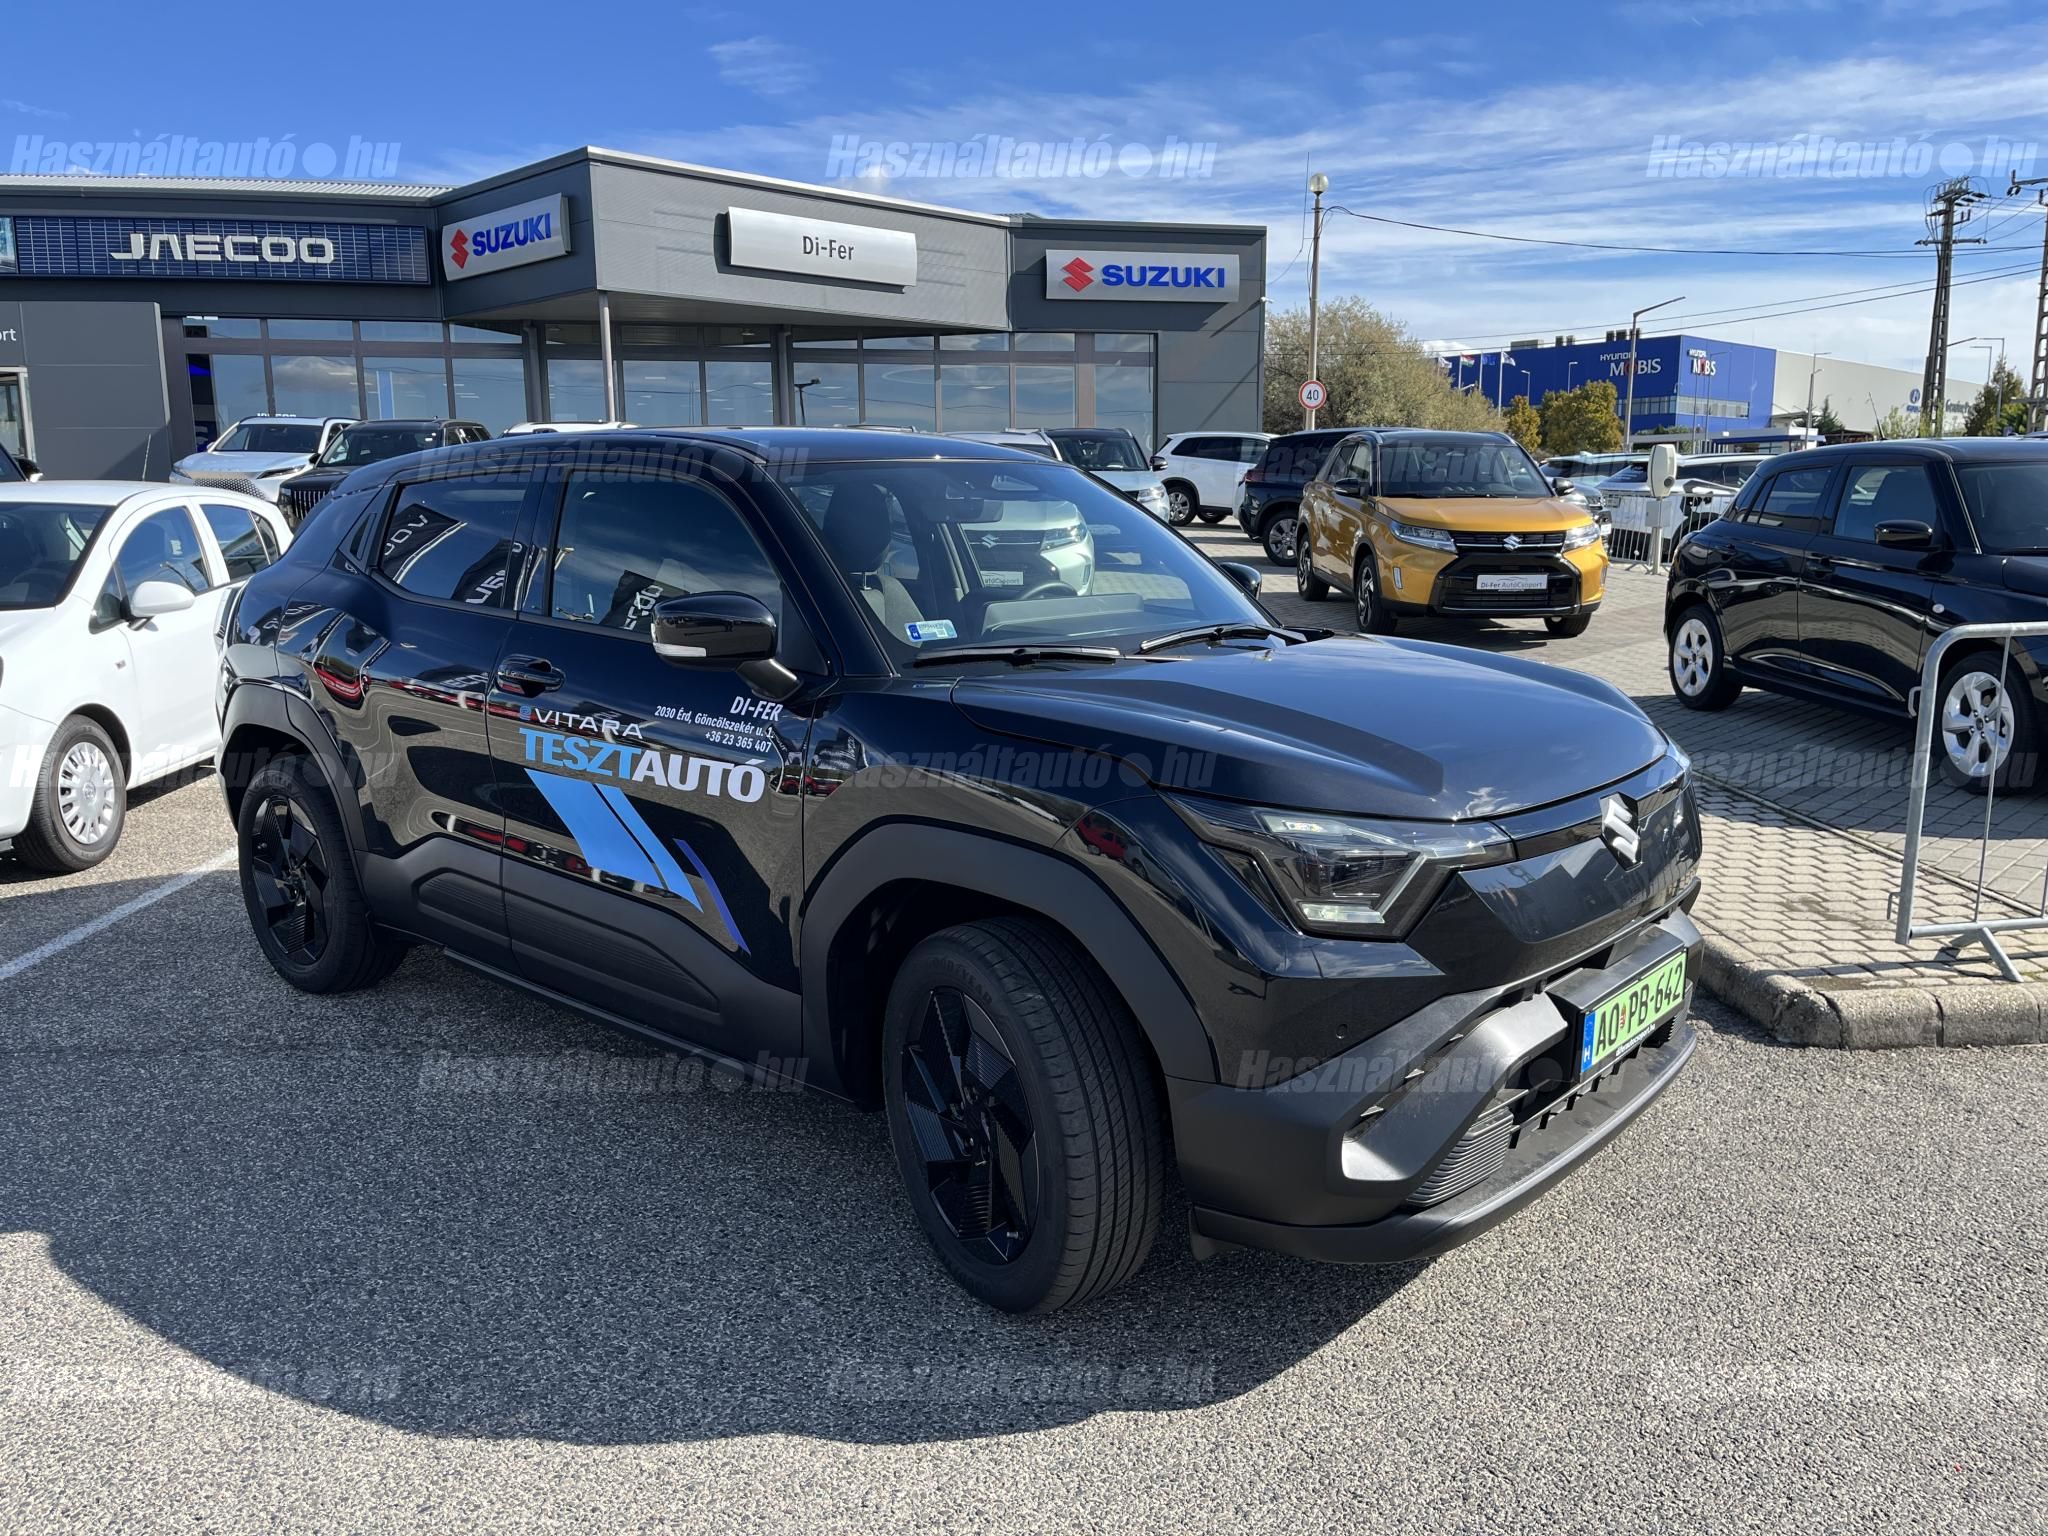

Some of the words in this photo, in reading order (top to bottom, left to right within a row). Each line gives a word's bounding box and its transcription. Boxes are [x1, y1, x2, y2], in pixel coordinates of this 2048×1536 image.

[110, 233, 334, 264] JAECOO
[472, 213, 552, 256] SUZUKI
[802, 235, 855, 260] Di-Fer
[1102, 264, 1226, 288] SUZUKI
[1306, 389, 1319, 401] 40
[655, 705, 676, 719] 2030
[676, 707, 692, 724] Érd,
[755, 726, 764, 736] u.
[730, 696, 783, 722] DI-FER
[705, 730, 721, 743] +36
[722, 733, 735, 746] 23
[735, 736, 753, 750] 365
[754, 741, 772, 753] 407
[519, 727, 766, 803] TESZTAUTÓ
[1596, 1003, 1620, 1056] AO
[1627, 961, 1683, 1034] PB-642
